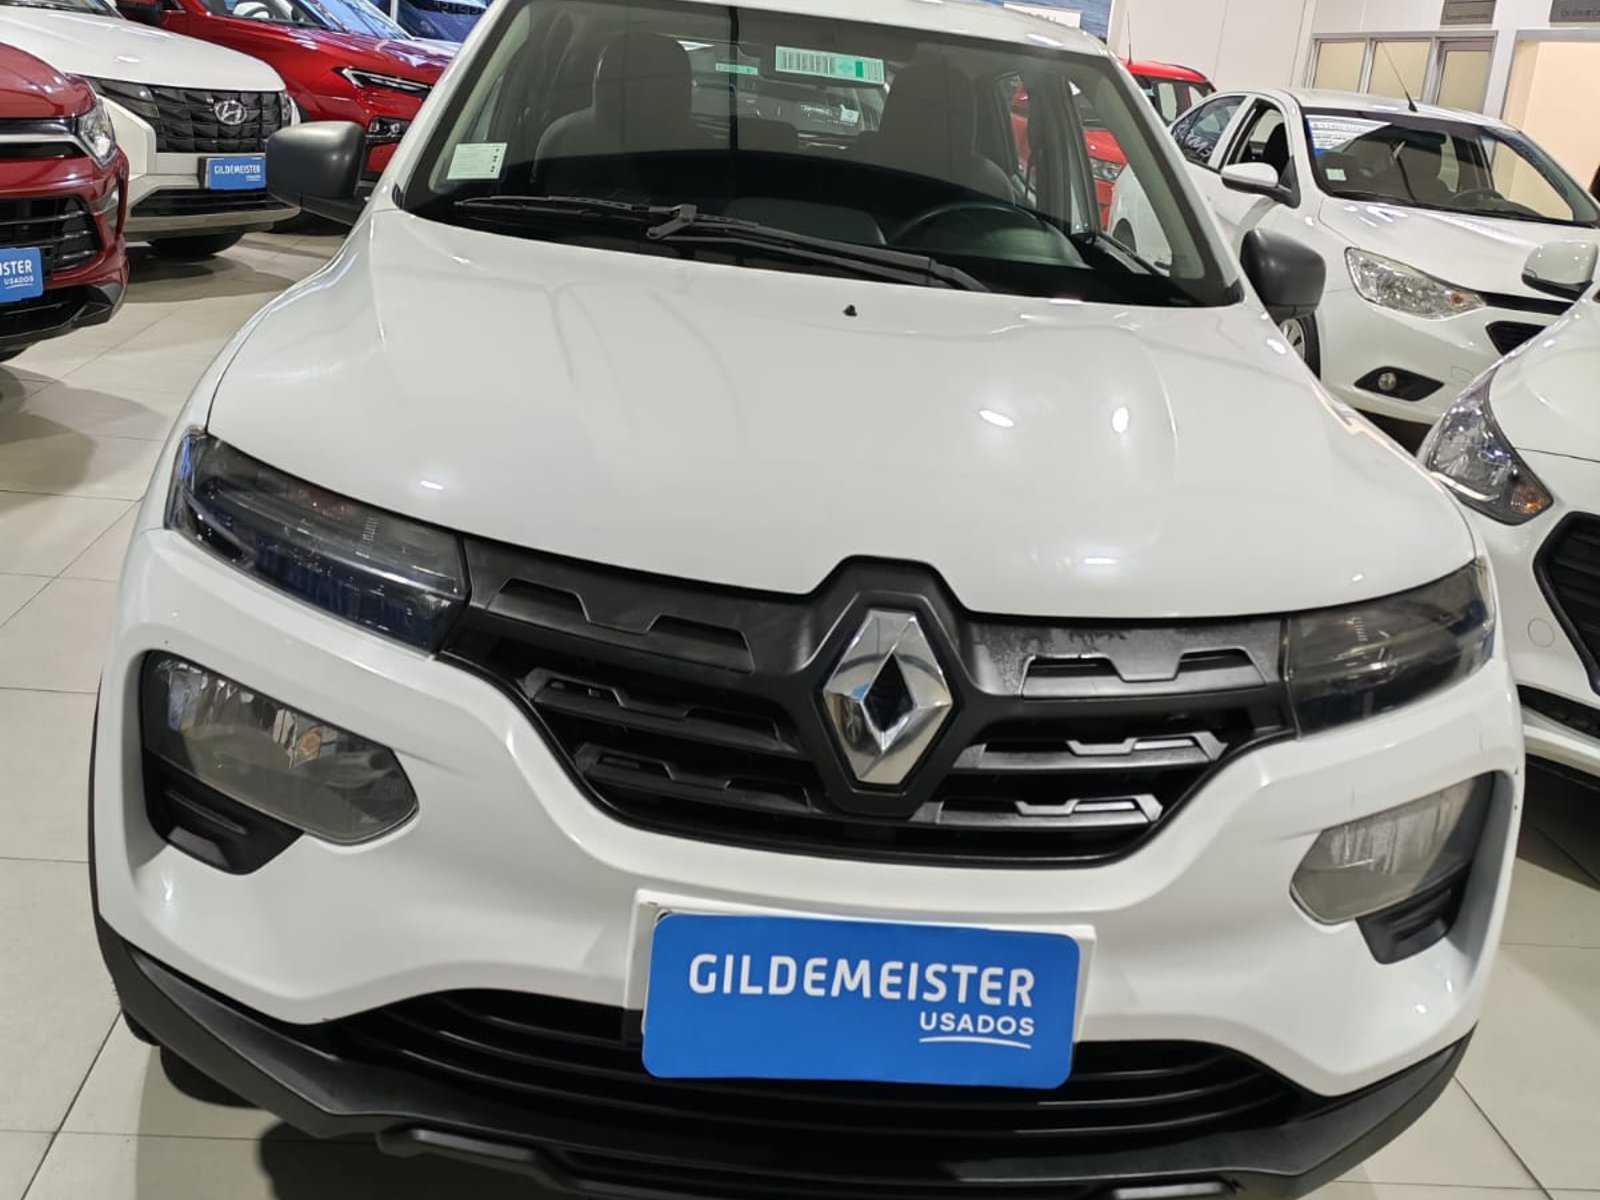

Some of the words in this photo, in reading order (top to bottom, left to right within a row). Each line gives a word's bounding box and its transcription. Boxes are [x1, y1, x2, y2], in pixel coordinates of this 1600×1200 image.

[214, 165, 260, 174] GILDEMEISTER
[688, 953, 1036, 1008] GILDEMEISTER
[919, 1010, 1035, 1036] USADOS
